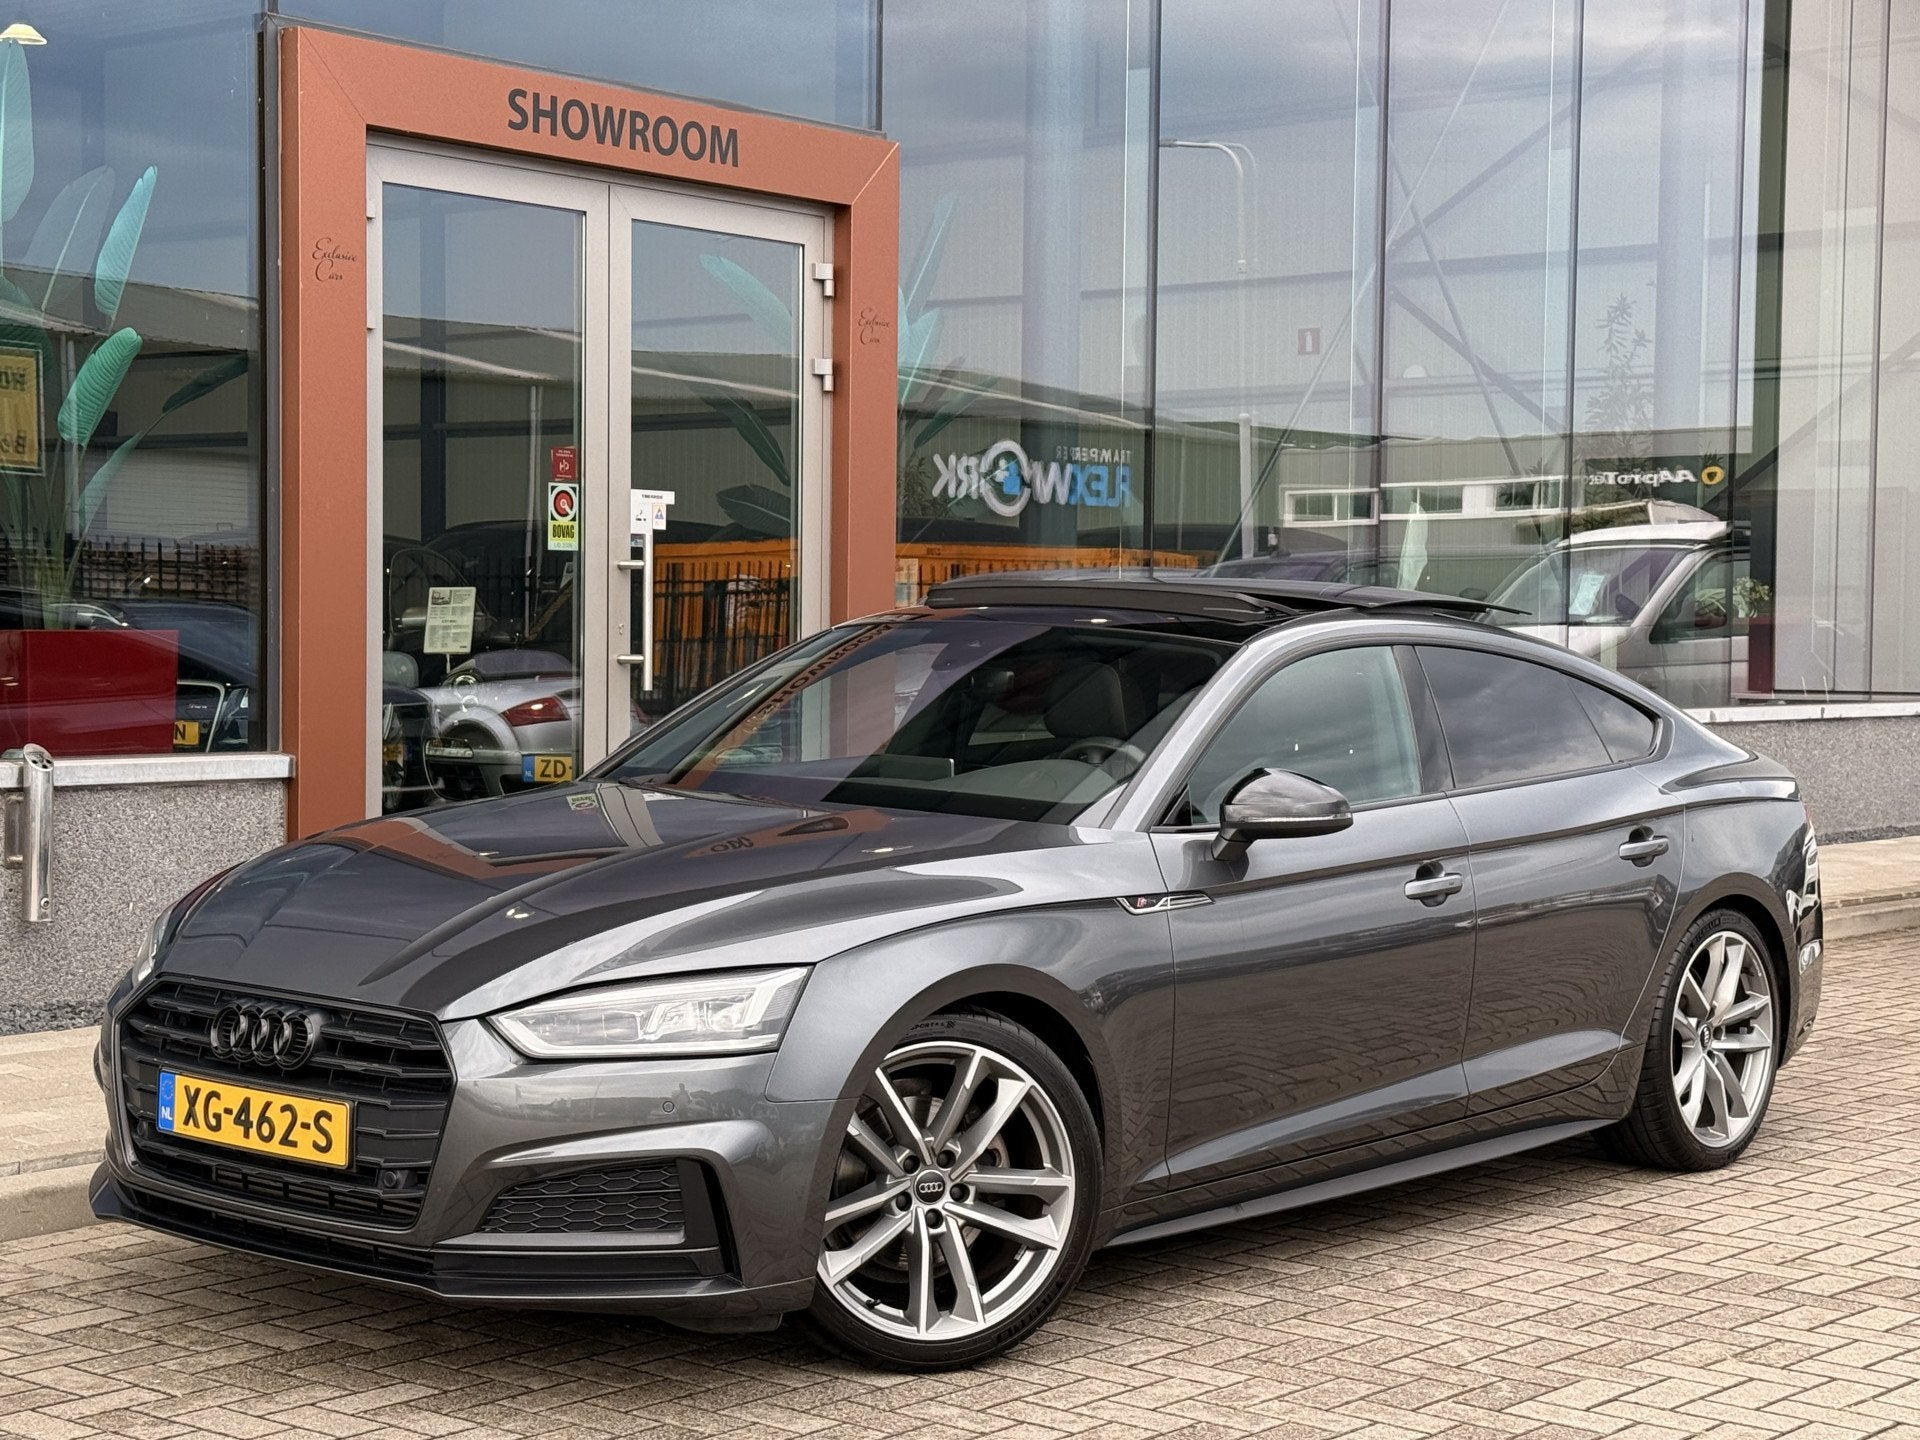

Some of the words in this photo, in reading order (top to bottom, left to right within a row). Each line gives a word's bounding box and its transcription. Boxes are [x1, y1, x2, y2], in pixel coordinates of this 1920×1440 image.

[508, 88, 739, 168] SHOWROOM
[552, 523, 575, 539] BOVAG
[161, 1105, 173, 1121] NL
[182, 1084, 334, 1154] XG-462-S
